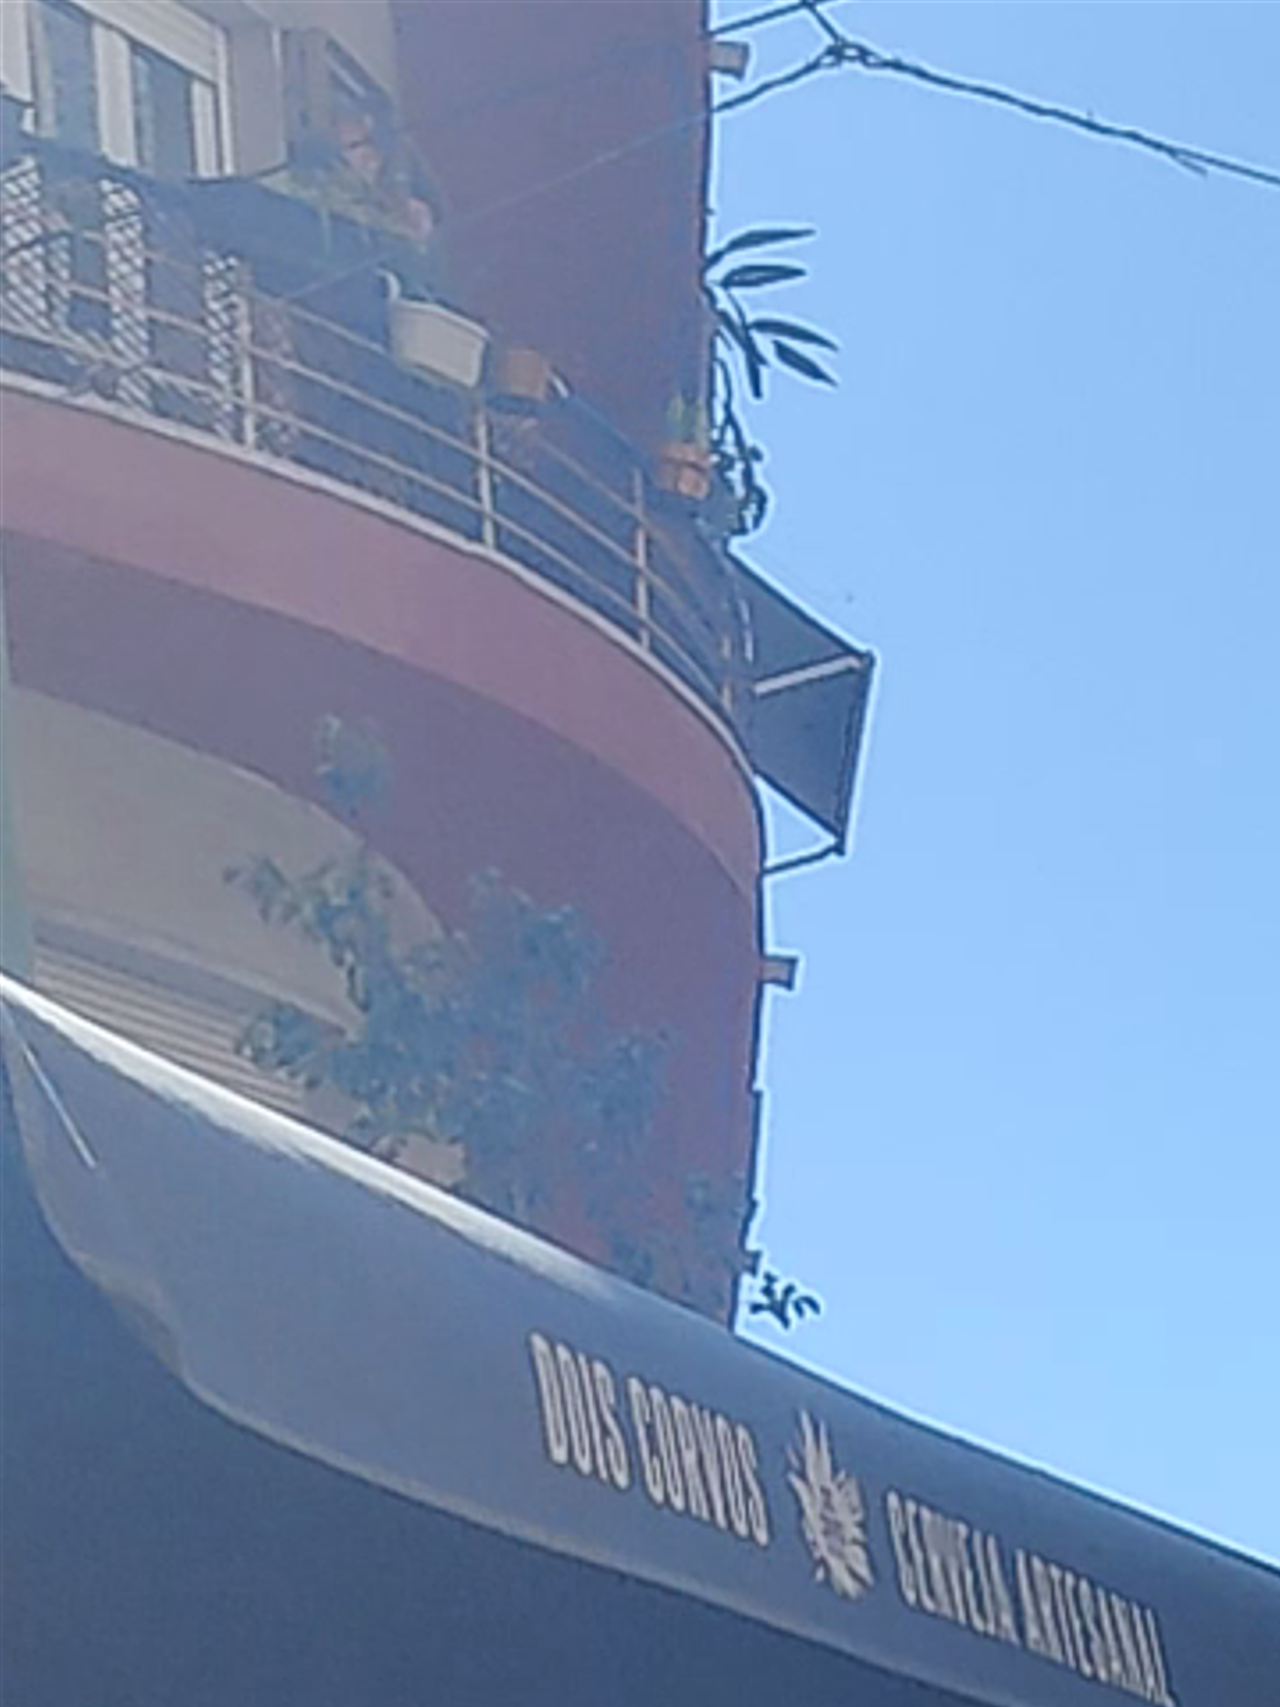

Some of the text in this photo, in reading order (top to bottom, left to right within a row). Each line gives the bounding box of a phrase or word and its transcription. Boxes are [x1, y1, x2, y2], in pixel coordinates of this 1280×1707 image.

[530, 1330, 770, 1547] DOIS CORVOS
[886, 1489, 1021, 1648] CERVEJA
